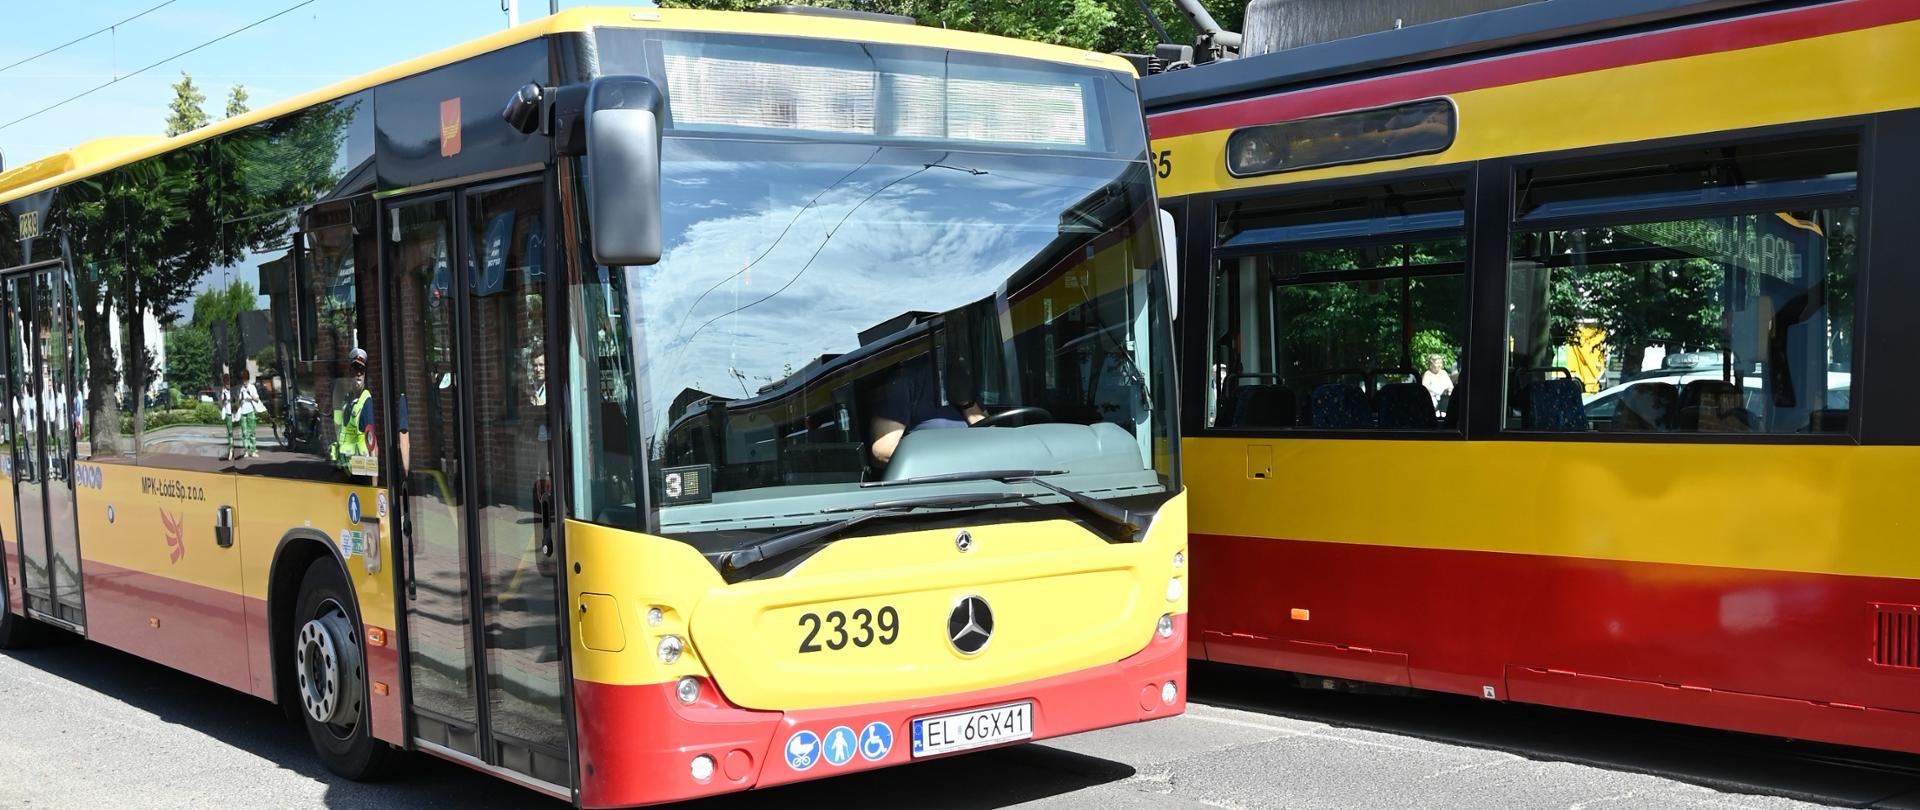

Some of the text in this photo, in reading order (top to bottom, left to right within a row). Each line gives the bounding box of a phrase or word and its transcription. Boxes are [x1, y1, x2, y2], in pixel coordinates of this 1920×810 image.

[20, 212, 37, 238] 2339
[798, 606, 899, 654] 2339
[928, 708, 1024, 747] EL 6GX41
